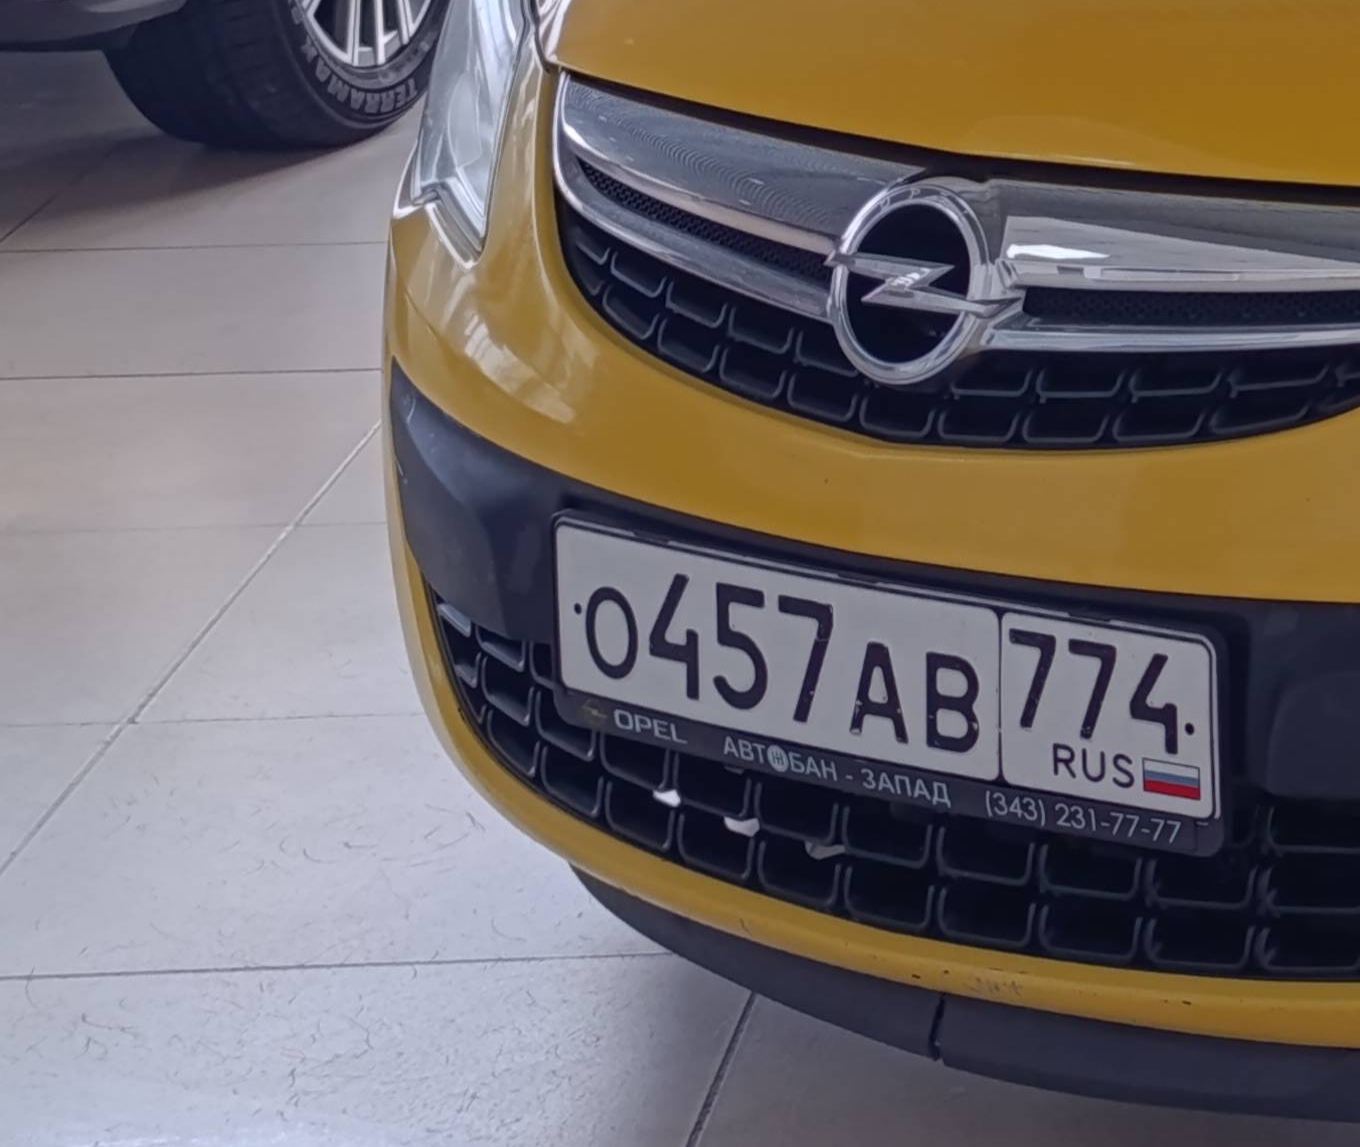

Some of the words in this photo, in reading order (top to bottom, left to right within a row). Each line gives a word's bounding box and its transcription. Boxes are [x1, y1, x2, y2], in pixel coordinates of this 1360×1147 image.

[302, 34, 418, 114] TERRAMAX
[1009, 627, 1178, 755] 774
[613, 708, 688, 744] OPEL
[723, 735, 838, 782] АВТОБАН
[862, 767, 952, 808] ЗАПАД
[985, 790, 1047, 827] (343)
[1055, 803, 1182, 844] 231-77-77
[1052, 742, 1135, 788] RUS
